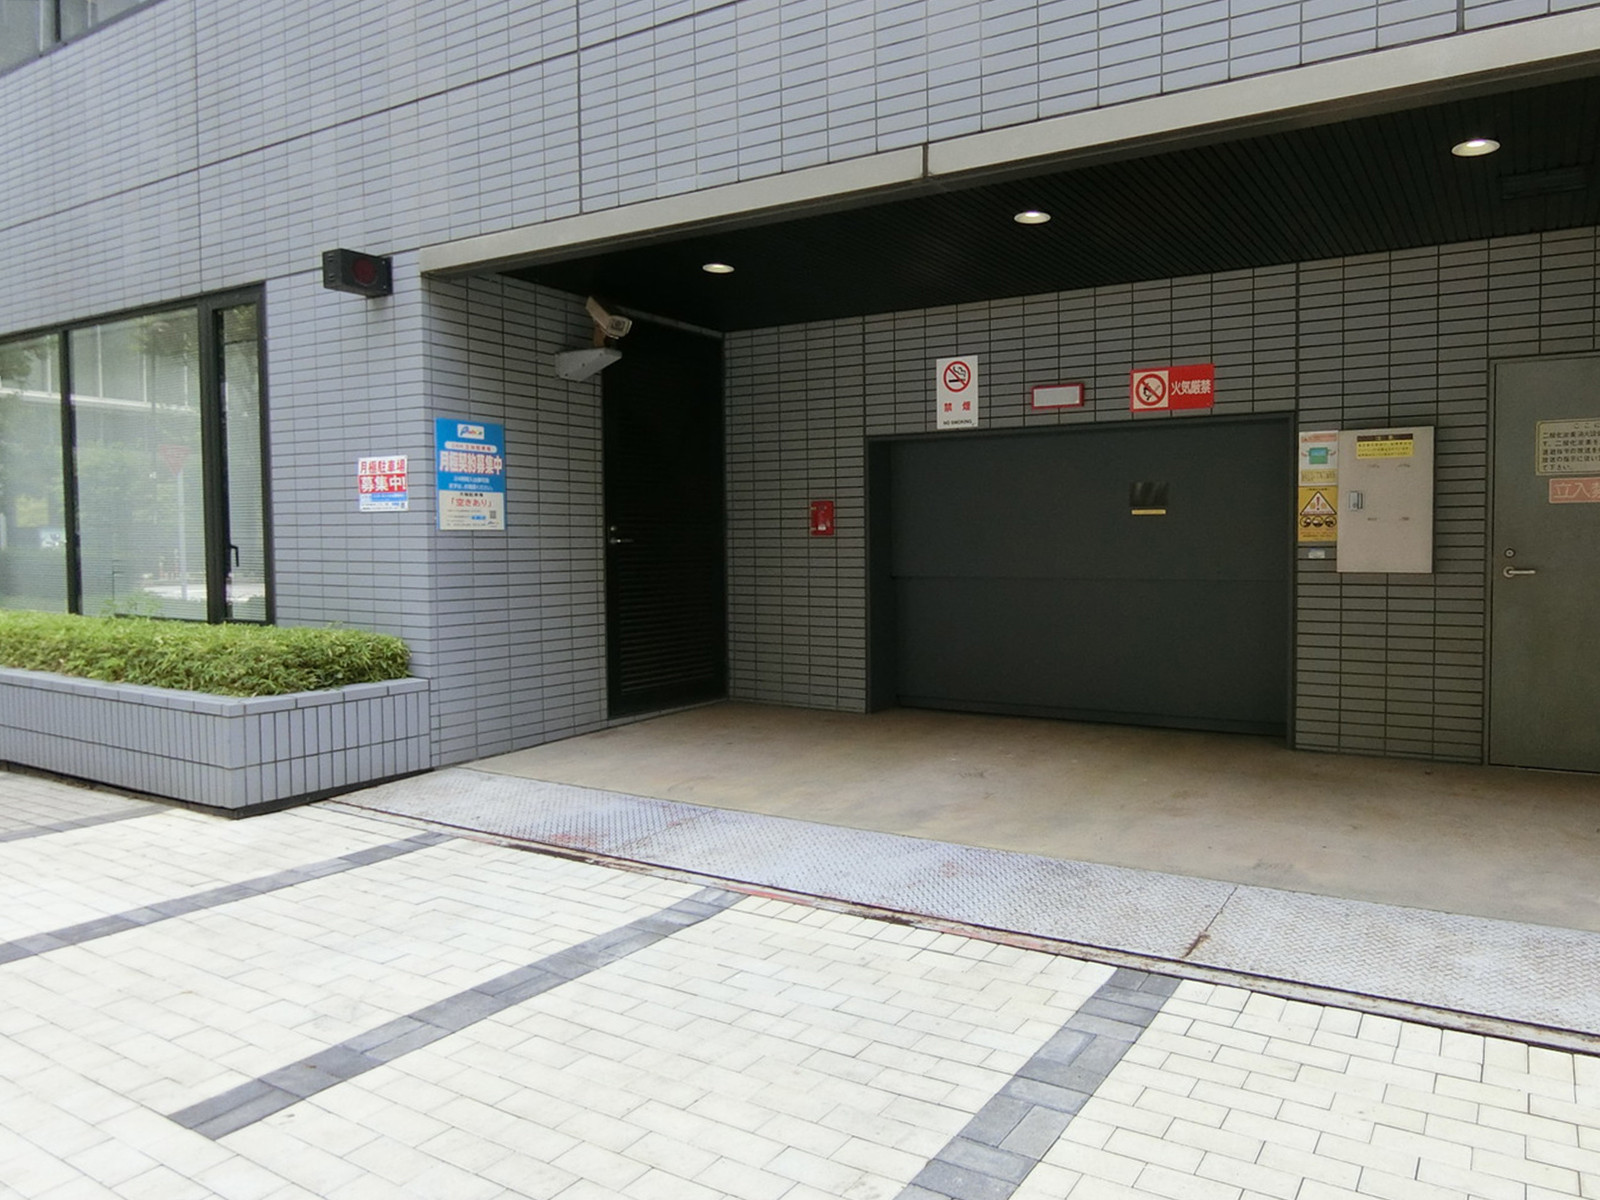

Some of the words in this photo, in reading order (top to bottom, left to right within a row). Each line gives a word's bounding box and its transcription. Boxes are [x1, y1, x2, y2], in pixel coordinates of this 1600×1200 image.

[1171, 379, 1211, 396] 火気厳禁
[361, 459, 405, 474] 月極駐車場
